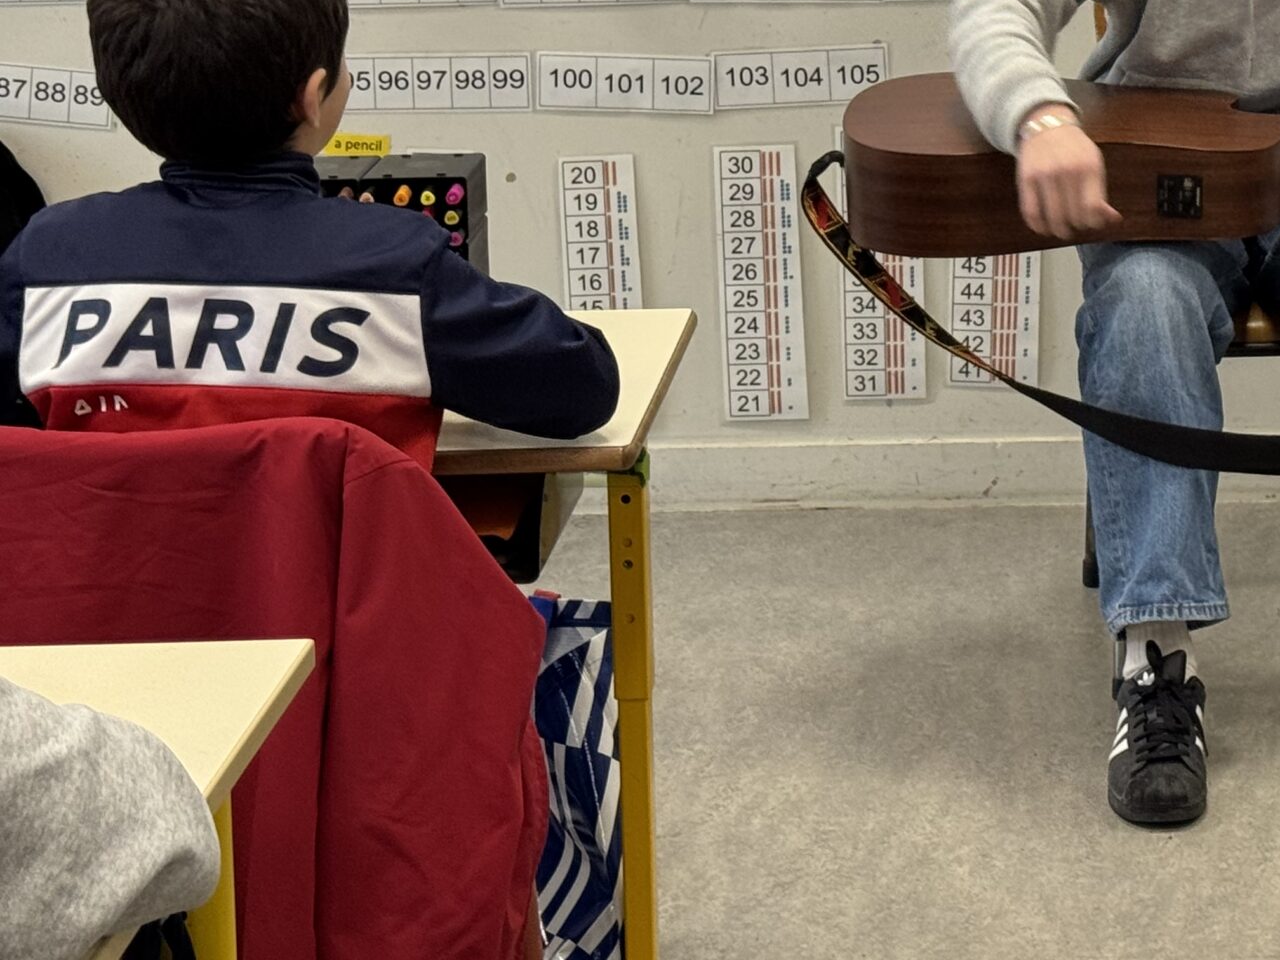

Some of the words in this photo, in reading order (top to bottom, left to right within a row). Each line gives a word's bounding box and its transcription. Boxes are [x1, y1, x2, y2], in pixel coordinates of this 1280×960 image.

[349, 71, 371, 91] 5
[379, 71, 409, 90] 96
[417, 71, 446, 90] 97
[455, 70, 485, 89] 98
[493, 70, 524, 89] 99
[550, 69, 592, 88] 100
[605, 74, 643, 93] 101
[662, 76, 703, 95] 102
[727, 66, 768, 86] 103
[781, 67, 823, 87] 104
[837, 65, 879, 84] 105
[35, 82, 65, 102] 88
[334, 139, 342, 149] a
[345, 140, 383, 152] pencil
[729, 157, 752, 174] 30
[571, 167, 596, 184] 20
[730, 183, 753, 201] 29
[574, 193, 597, 210] 19
[731, 210, 755, 227] 28
[576, 221, 599, 237] 18
[732, 237, 755, 254] 27
[577, 247, 599, 264] 17
[733, 263, 757, 280] 26
[961, 257, 987, 273] 45
[579, 274, 601, 290] 16
[734, 290, 758, 307] 25
[961, 283, 984, 300] 44
[852, 296, 877, 313] 34
[735, 317, 758, 333] 24
[960, 310, 984, 326] 43
[50, 297, 371, 378] PARIS
[853, 323, 877, 340] 33
[736, 343, 760, 360] 23
[854, 349, 877, 365] 32
[737, 369, 760, 386] 22
[958, 363, 982, 377] 41
[855, 375, 875, 391] 31
[738, 396, 759, 412] 21
